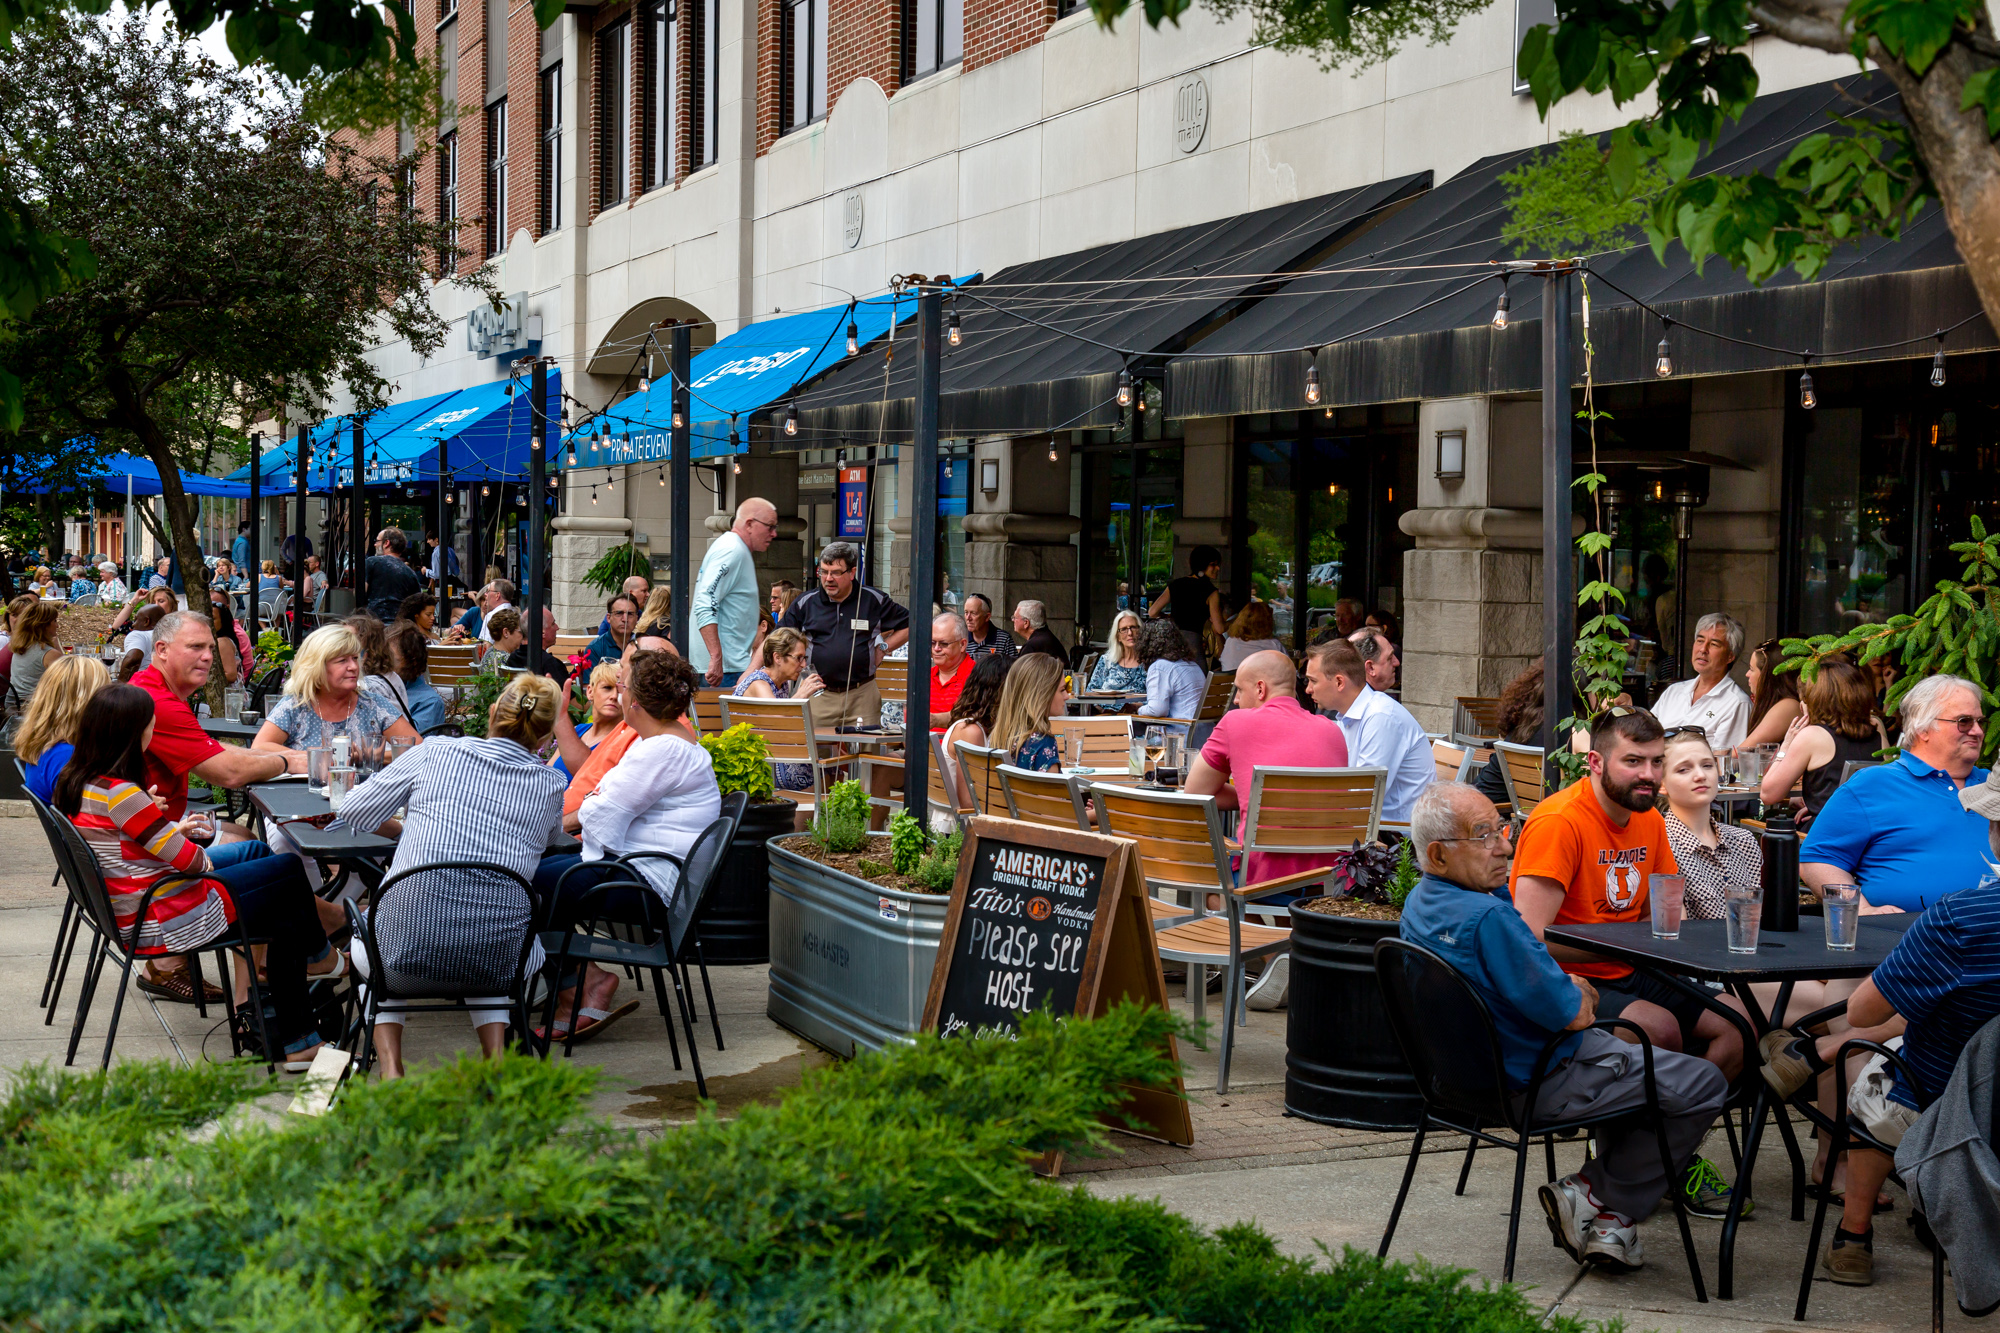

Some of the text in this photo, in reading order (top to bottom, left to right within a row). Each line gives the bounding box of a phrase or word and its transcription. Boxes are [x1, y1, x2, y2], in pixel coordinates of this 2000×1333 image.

[1178, 121, 1202, 143] main
[849, 469, 861, 481] ATM
[994, 848, 1088, 887] AMERICA'S
[992, 870, 1030, 888] ORIGINAL
[1031, 878, 1058, 893] CRAFT
[969, 886, 1025, 918] Tito's
[1052, 902, 1097, 921] Handmade
[1057, 916, 1088, 931] VODKA
